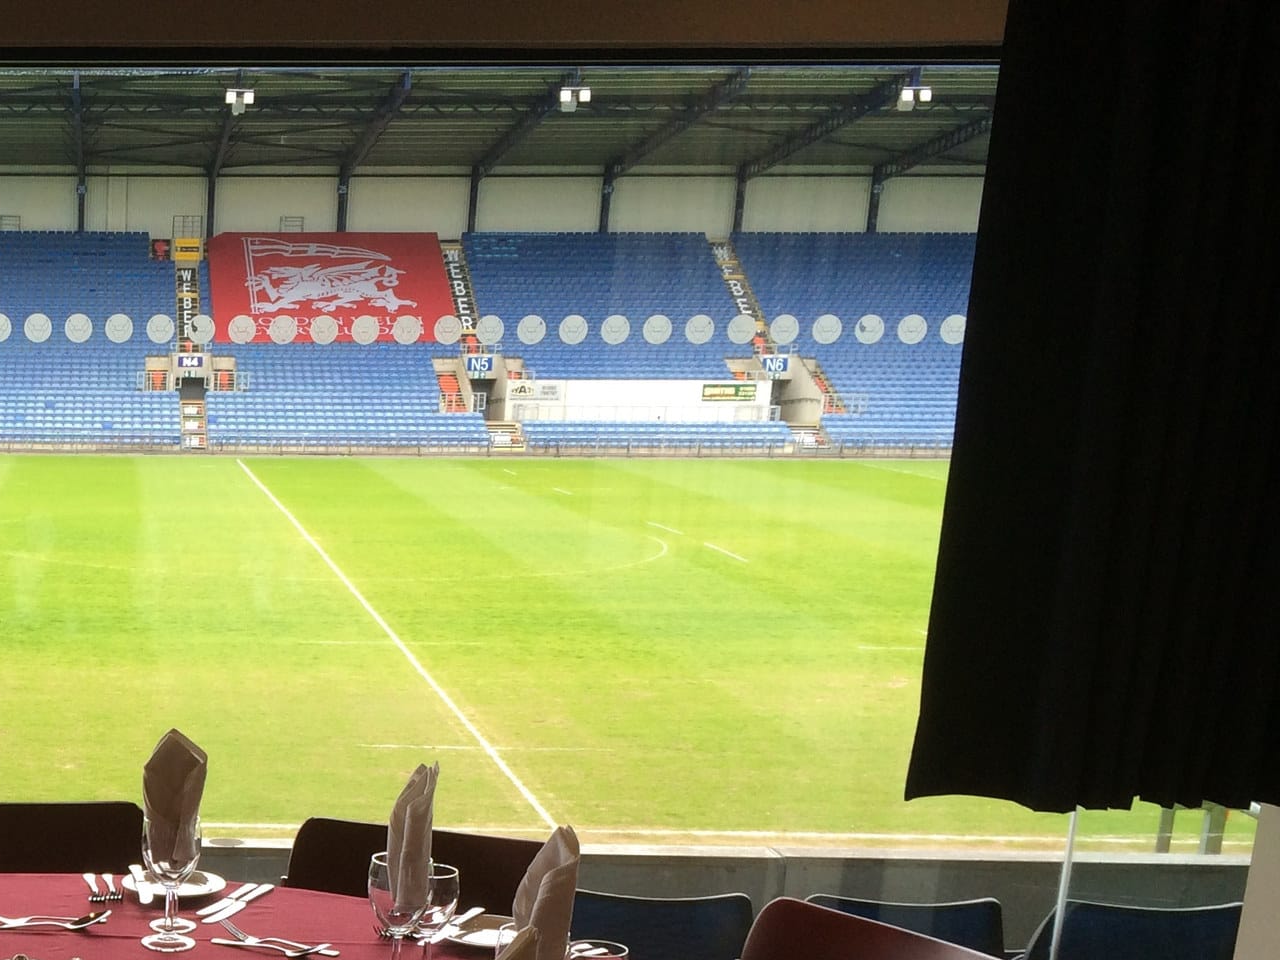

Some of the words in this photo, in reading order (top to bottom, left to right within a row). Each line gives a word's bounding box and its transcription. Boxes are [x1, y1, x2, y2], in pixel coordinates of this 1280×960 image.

[446, 249, 473, 330] WEBER
[182, 357, 199, 367] N4
[471, 357, 489, 371] N5
[766, 358, 784, 372] N6
